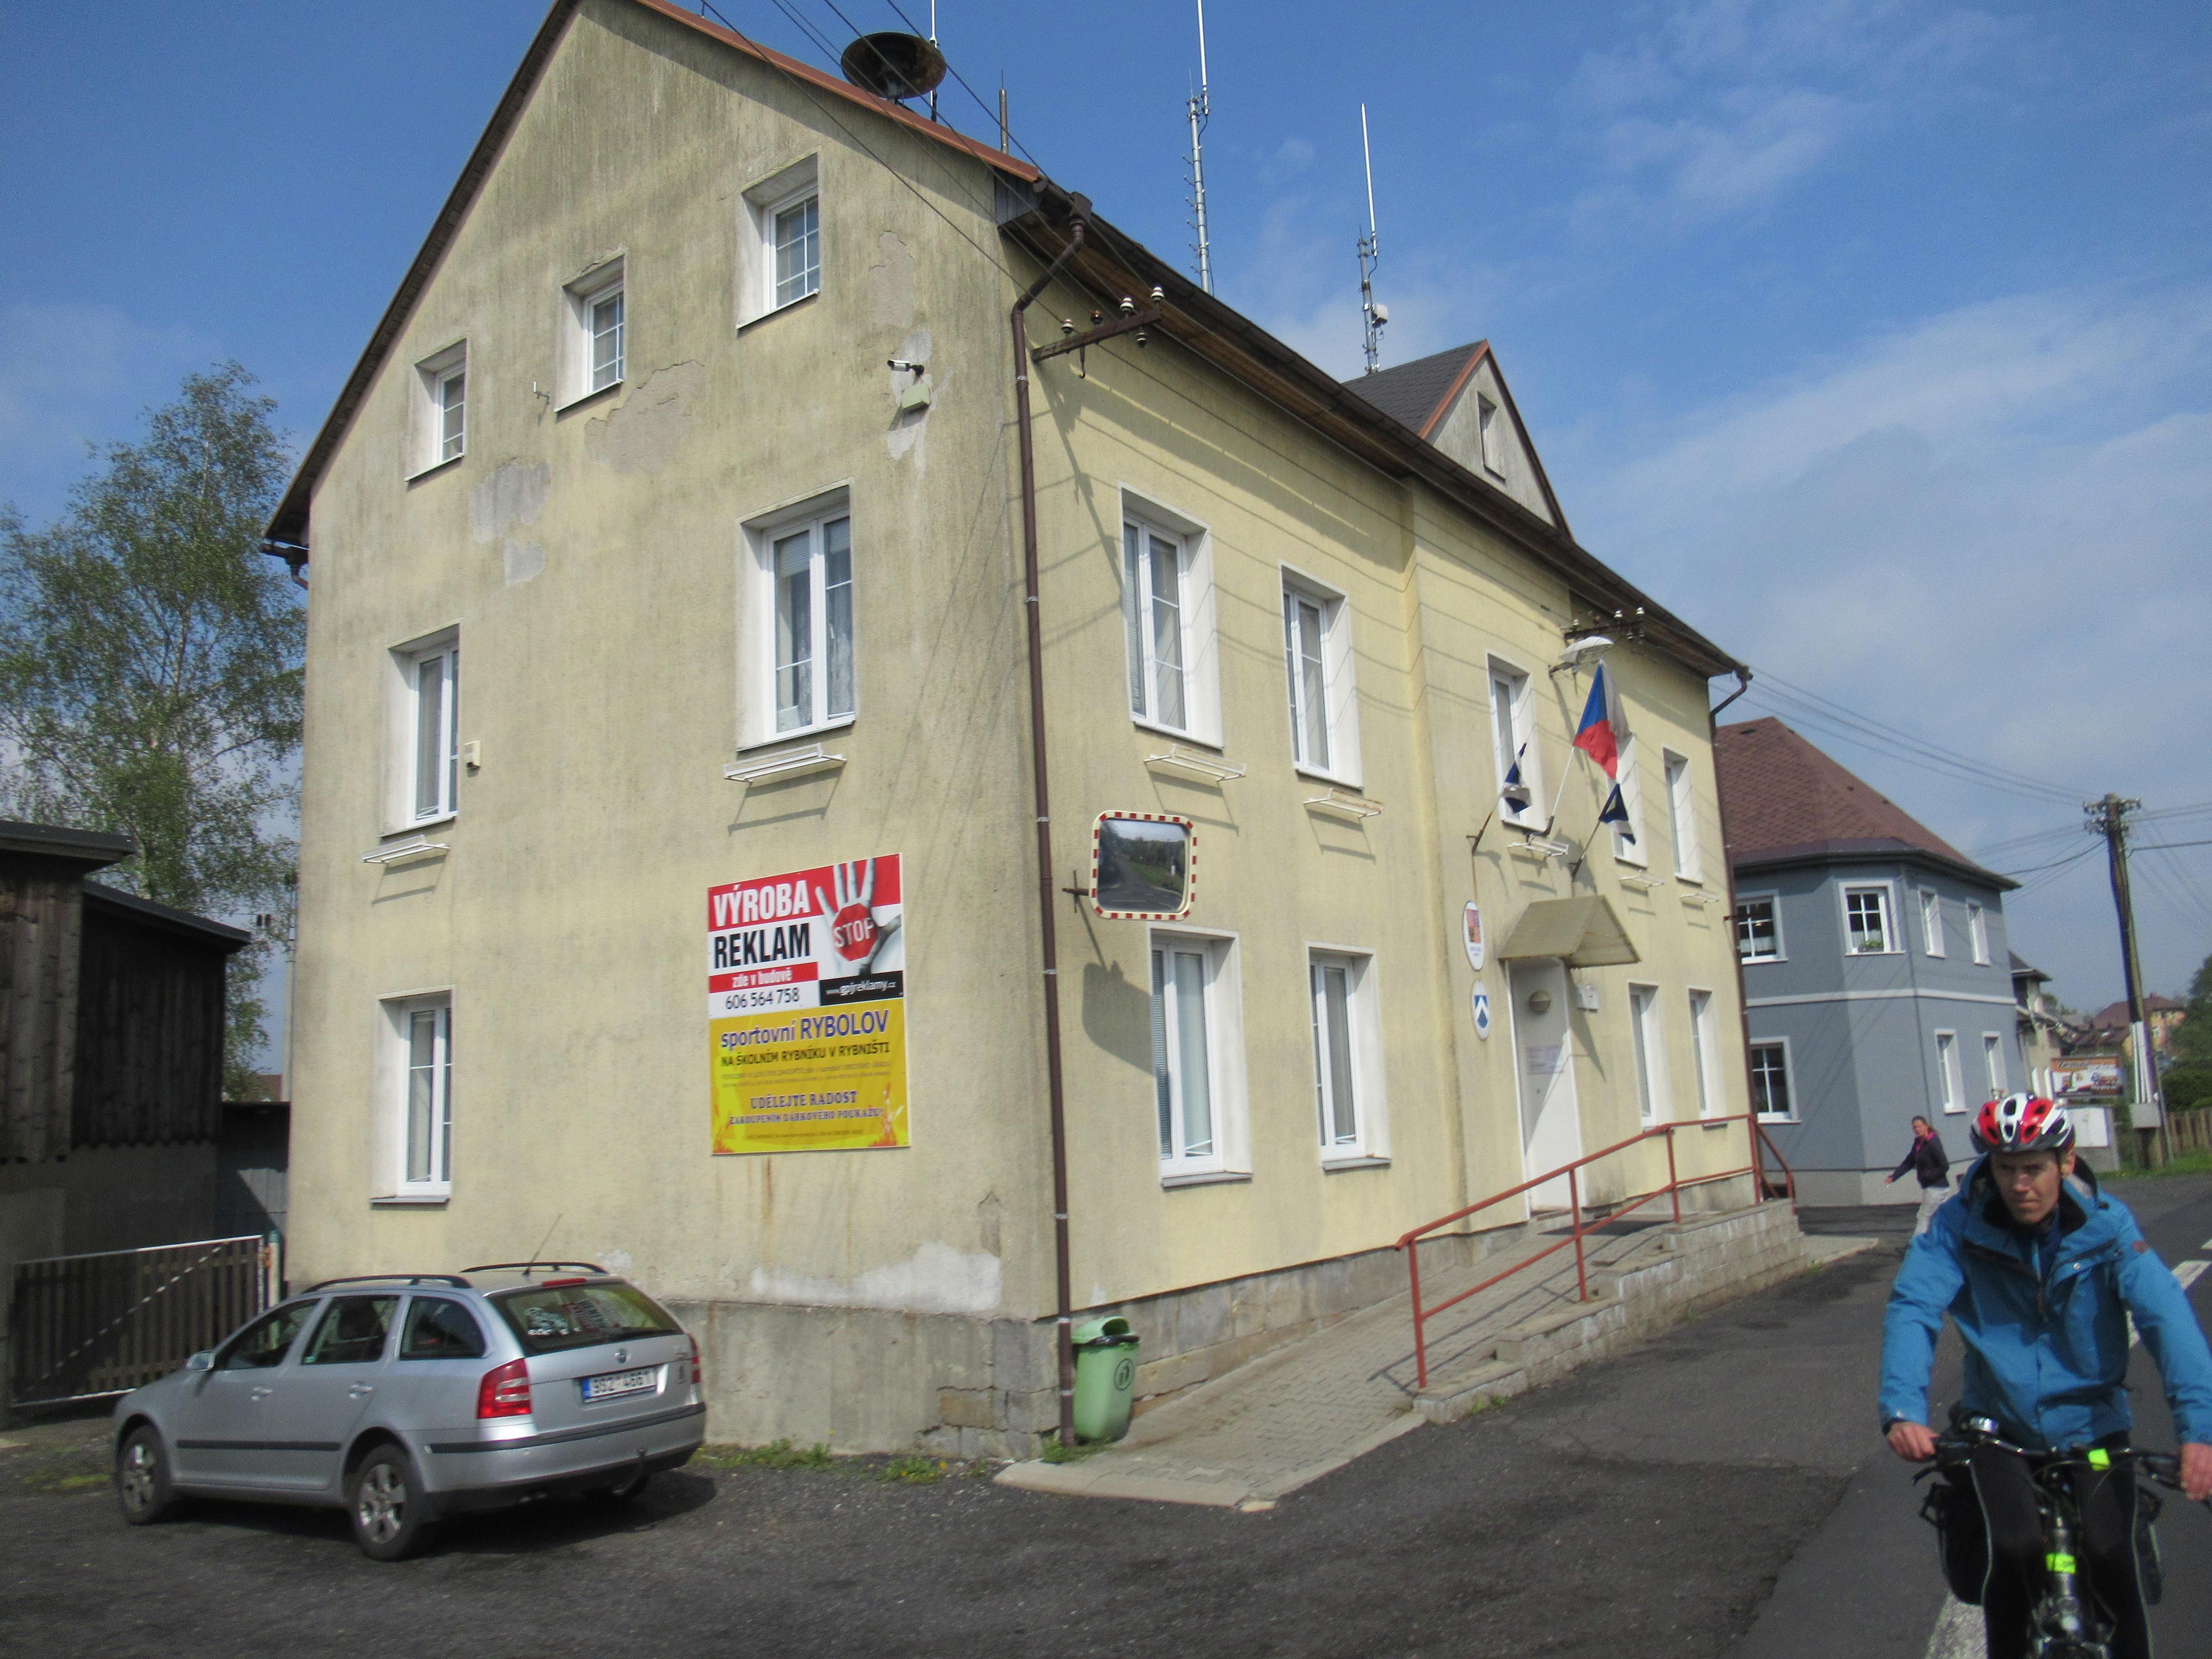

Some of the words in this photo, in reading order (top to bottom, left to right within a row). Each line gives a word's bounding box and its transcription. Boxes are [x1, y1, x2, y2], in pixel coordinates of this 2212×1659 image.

[713, 880, 811, 927] VÝROBA
[714, 922, 810, 969] REKLAM
[833, 917, 875, 948] STOP
[732, 974, 749, 988] zde
[750, 974, 757, 986] v
[758, 967, 792, 985] budově
[726, 994, 748, 1009] 606
[751, 991, 773, 1006] 564
[776, 987, 800, 1004] 758
[721, 1019, 796, 1051] sportovní
[800, 1009, 889, 1040] RYBOLOV
[721, 1056, 734, 1066] NA
[736, 1049, 778, 1066] ŠKOLNÍM
[781, 1045, 826, 1062] RYBNÍKU
[828, 1046, 836, 1057] V
[838, 1040, 890, 1056] RYBNIŠTI
[750, 1094, 806, 1109] UDĚLEJTE
[810, 1090, 857, 1105] RADOST
